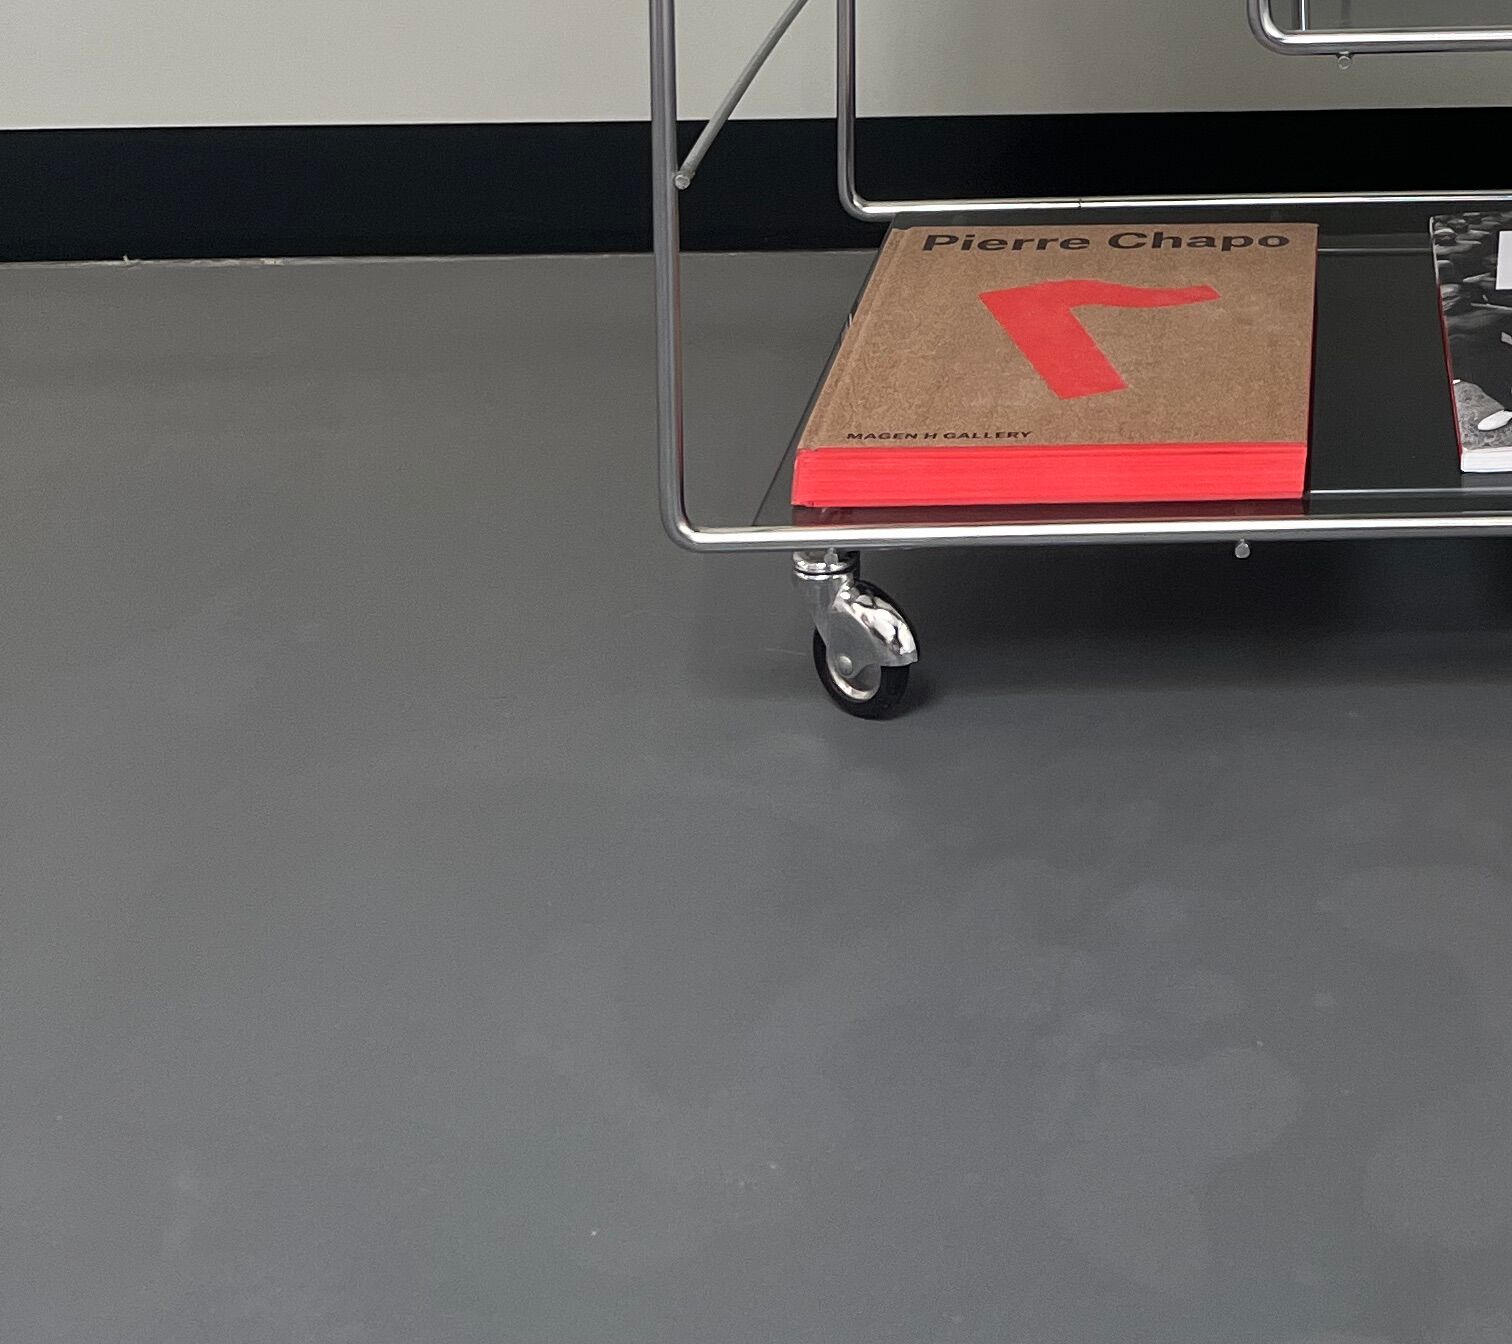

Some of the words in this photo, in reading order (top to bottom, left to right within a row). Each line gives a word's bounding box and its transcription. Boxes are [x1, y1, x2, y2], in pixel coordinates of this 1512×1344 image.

[921, 233, 1091, 252] Pierre
[1108, 231, 1290, 252] Chapo
[846, 432, 918, 440] MAGEN
[923, 432, 938, 440] H
[943, 431, 1033, 440] GALLERY
